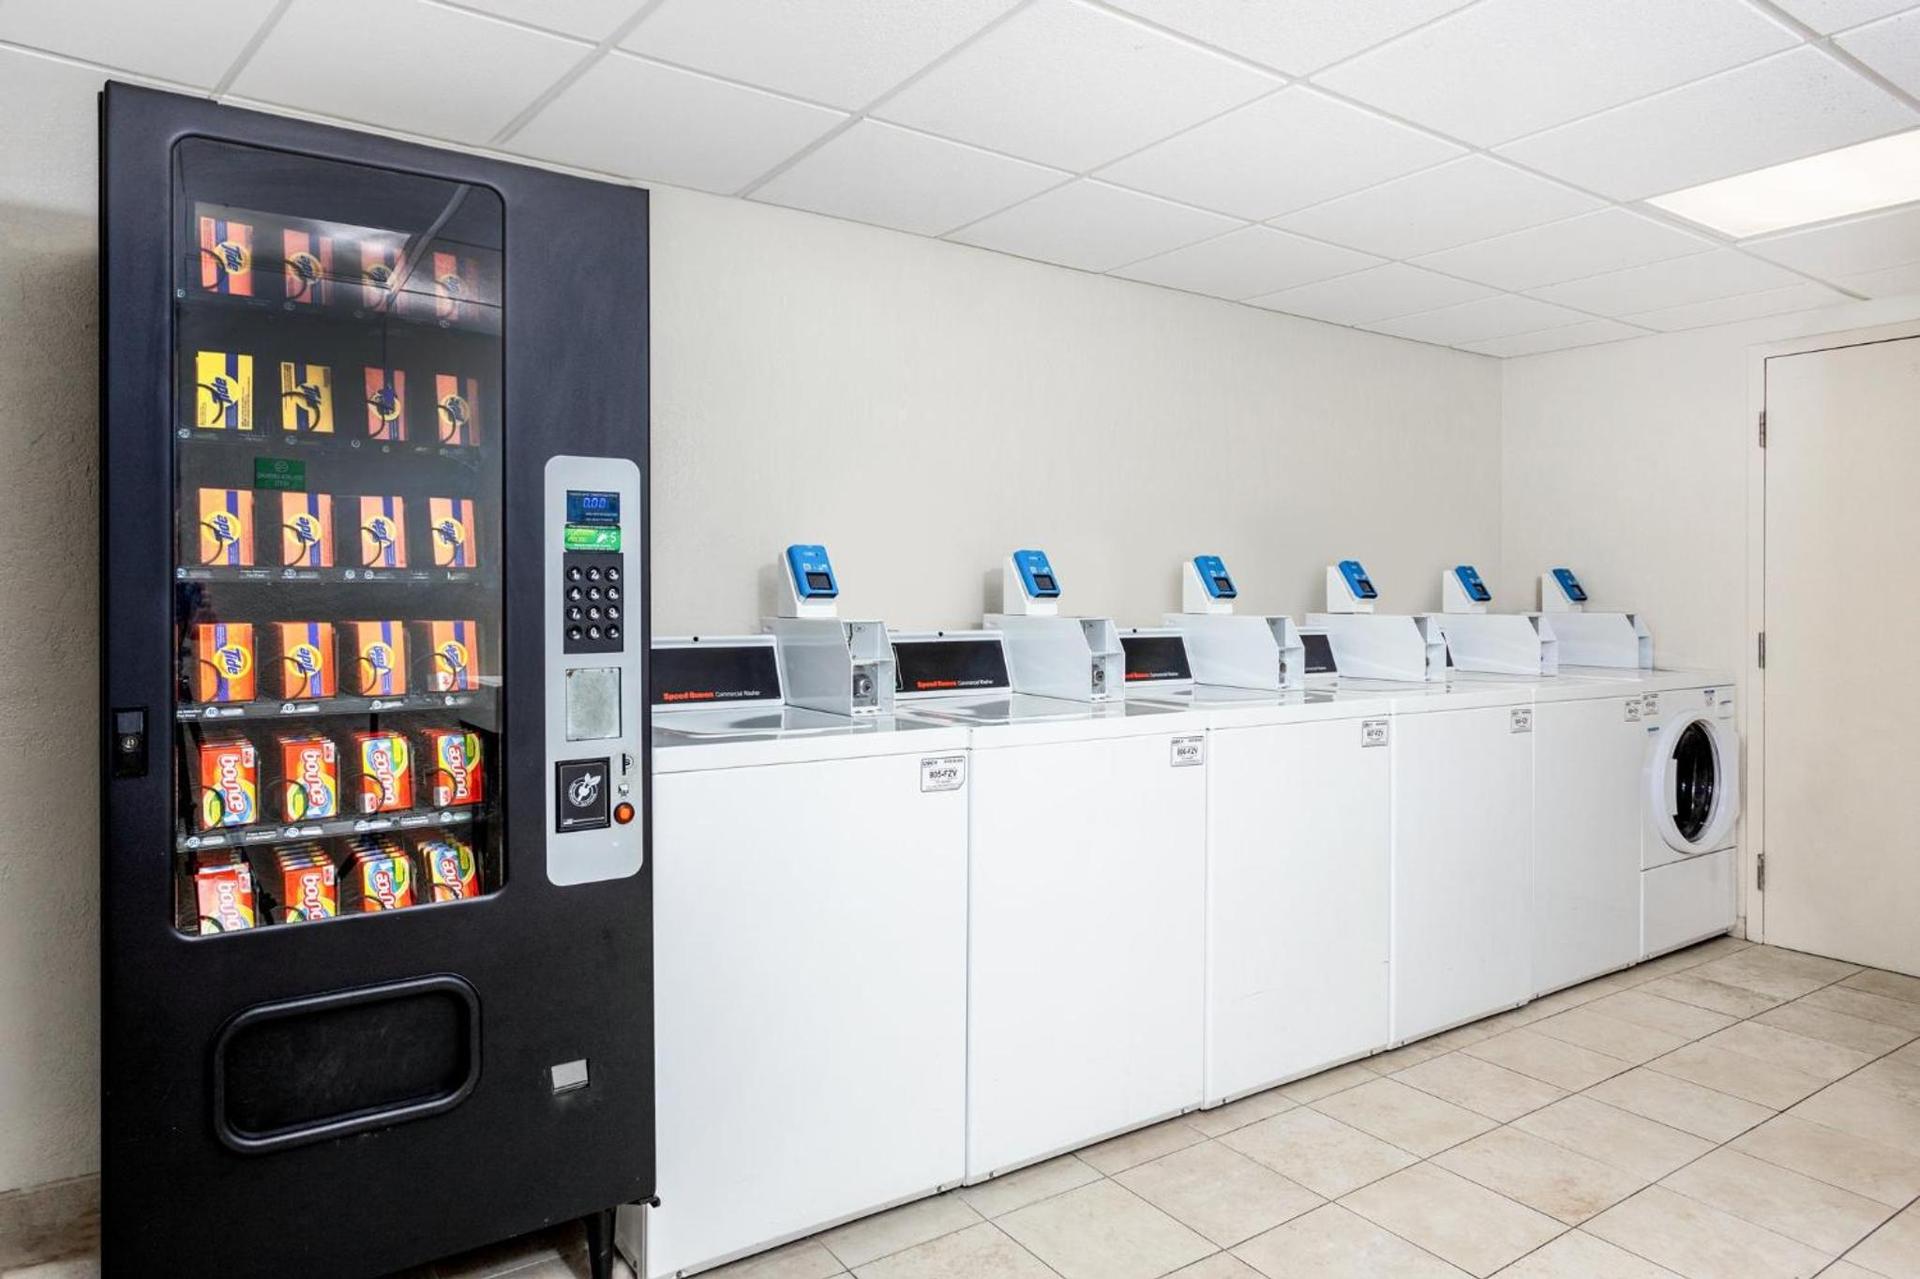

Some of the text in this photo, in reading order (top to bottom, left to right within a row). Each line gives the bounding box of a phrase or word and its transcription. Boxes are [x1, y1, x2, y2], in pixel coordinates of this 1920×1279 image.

[211, 376, 234, 405] Tide
[213, 514, 234, 543] Tide
[295, 516, 316, 544] Tide
[220, 648, 241, 675] Tide
[295, 648, 316, 674] Tide
[663, 691, 689, 701] Speed
